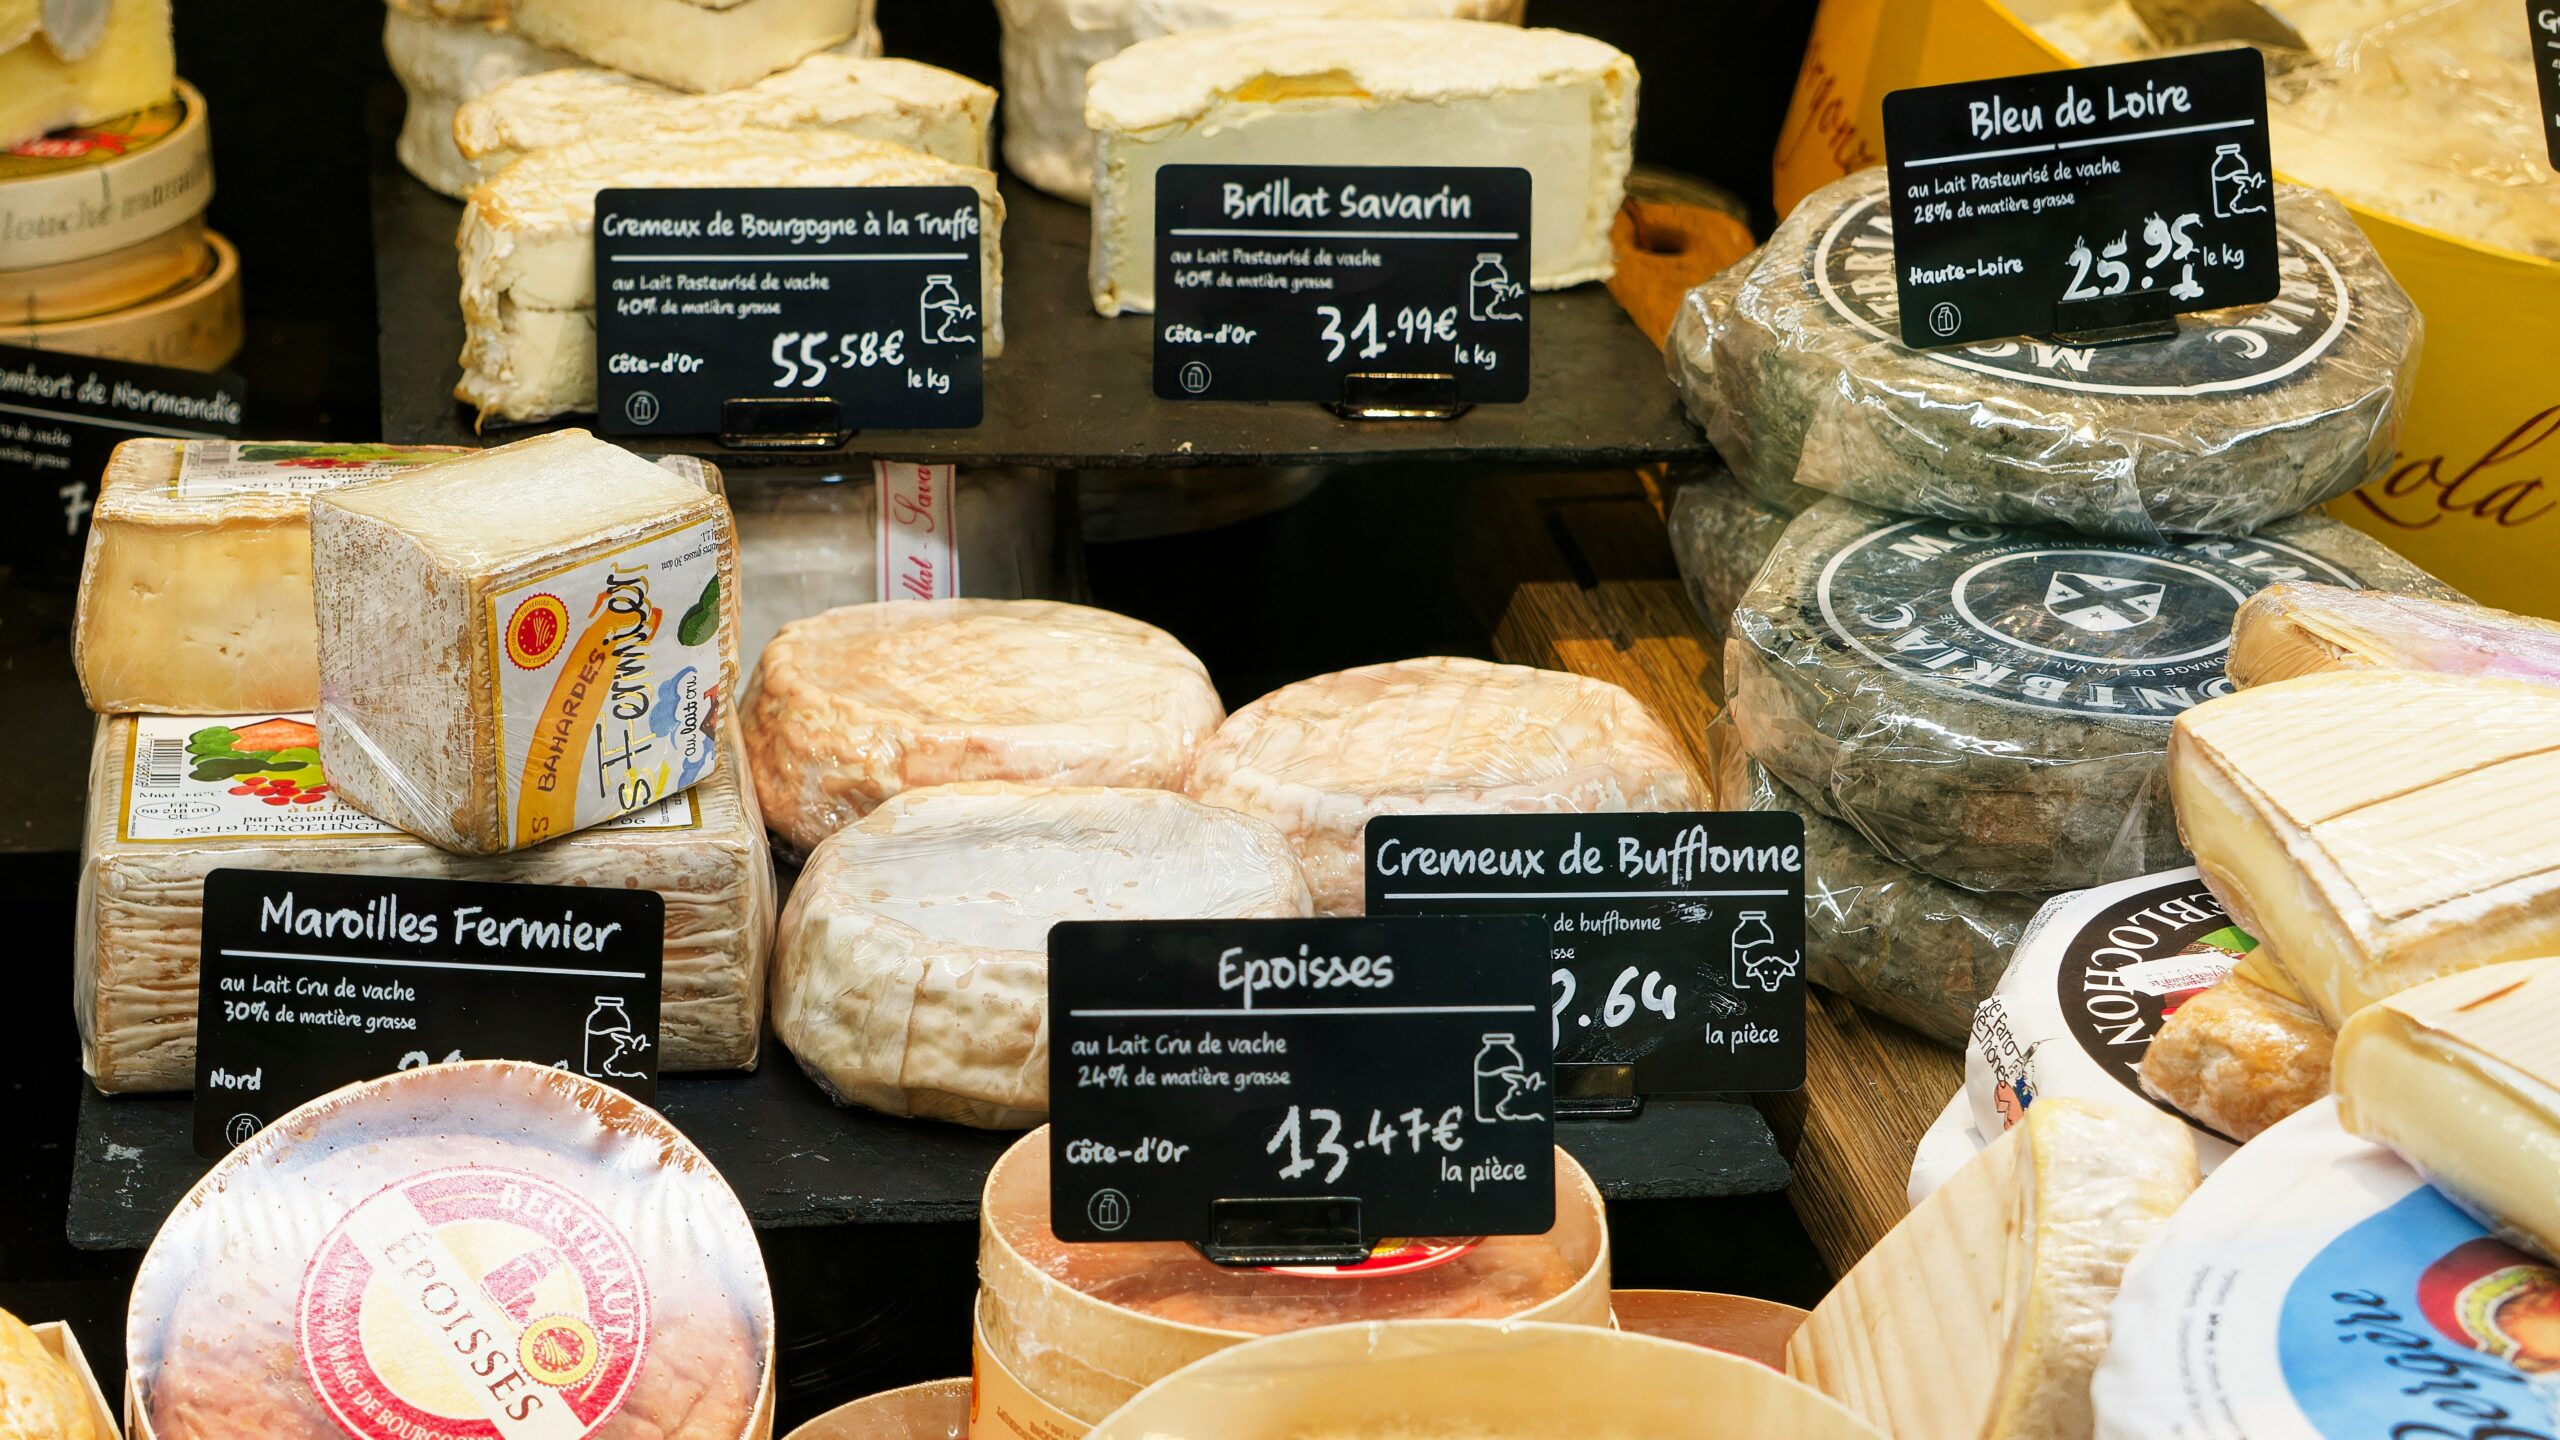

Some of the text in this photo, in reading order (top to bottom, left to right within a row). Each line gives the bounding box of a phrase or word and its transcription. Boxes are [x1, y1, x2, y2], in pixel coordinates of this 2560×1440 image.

[1969, 80, 2191, 140] Bleu de Loire
[1908, 156, 2120, 198] au Lait Pasteurisé de vache
[1223, 178, 1470, 219] Brillat Savarin
[1914, 194, 2074, 224] 28% de matière grasse
[603, 206, 978, 244] Cremeux de Bourgogne à la Truffe
[1171, 249, 1380, 266] au Lait Pasteurisé de vache
[1909, 256, 2023, 286] Haute-Loire
[2204, 243, 2244, 269] le kg
[613, 273, 829, 290] au Lait Pasteurisé de vache
[1175, 270, 1332, 293] 40% de matière grasse
[617, 297, 781, 319] 40% de matière grasse
[1165, 324, 1256, 344] Côte-d'Or
[1317, 304, 1461, 363] 31.99€
[609, 353, 703, 373] Côte-d'Or
[772, 330, 904, 387] 55.58€
[1455, 344, 1496, 370] le kg
[908, 368, 949, 394] le kg
[78, 371, 107, 405] de
[112, 380, 242, 425] Normandie
[596, 570, 652, 798] Fermier
[537, 648, 607, 792] BAHARDES
[680, 701, 698, 735] lait
[685, 734, 697, 757] au
[243, 815, 271, 825] par
[1377, 824, 1801, 885] Cremeux de Bufflonne
[261, 892, 621, 952] Maroilles Fermier
[1554, 910, 1661, 936] de bufflonne
[1550, 946, 1575, 961] sse
[2082, 892, 2226, 1045] EBLOCHON
[221, 974, 415, 1001] au Lait Cru de vache
[1217, 944, 1395, 1008] Epoisses
[224, 1001, 416, 1033] 30% de matière grasse
[1072, 1032, 1286, 1054] au Lait Cru de vache
[1706, 1022, 1779, 1053] la pièce
[211, 1068, 261, 1090] Nord
[1079, 1064, 1290, 1091] 24% de matière grasse
[1067, 1137, 1189, 1163] Côte-d'Or
[1266, 1105, 1463, 1183] 13.47€
[1442, 1156, 1526, 1192] la pièce
[499, 1183, 636, 1344] BERTHAUT
[327, 1344, 365, 1394] MARC
[352, 1390, 383, 1417] DE
